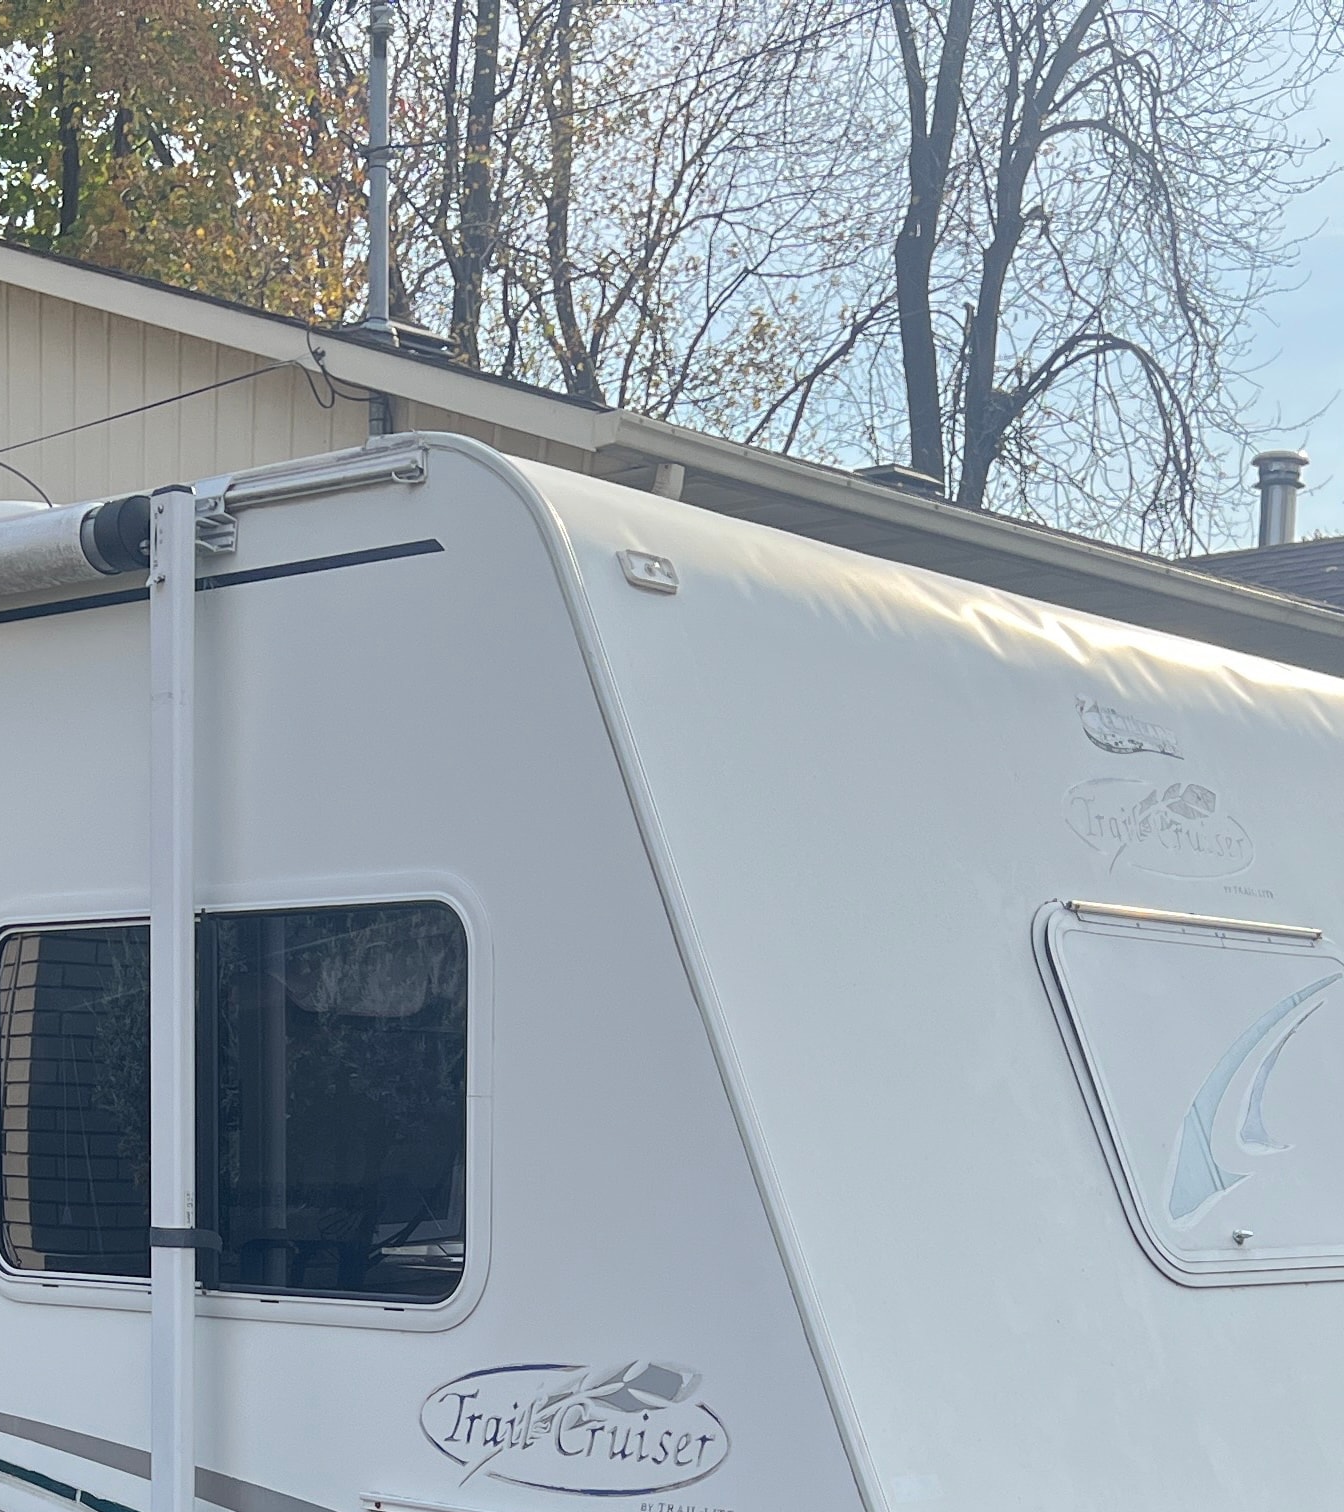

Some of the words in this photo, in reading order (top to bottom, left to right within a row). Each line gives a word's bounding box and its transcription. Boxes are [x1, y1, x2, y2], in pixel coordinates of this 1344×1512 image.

[438, 1389, 540, 1451] Trail
[555, 1402, 716, 1468] Cruiser
[640, 1503, 654, 1512] BY
